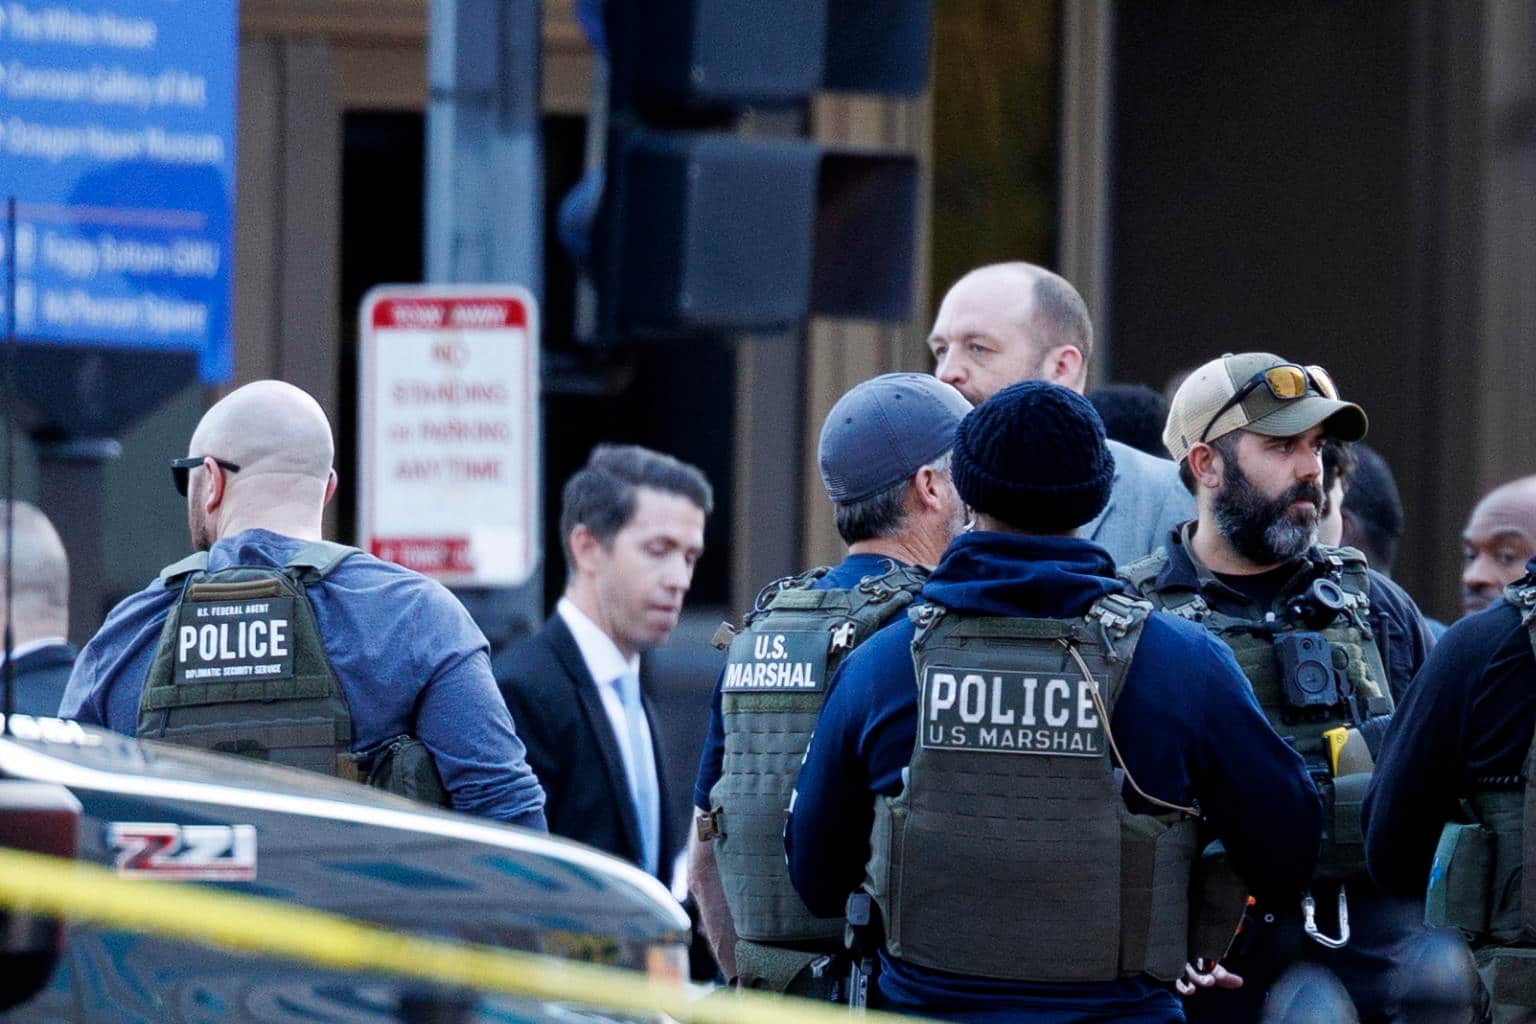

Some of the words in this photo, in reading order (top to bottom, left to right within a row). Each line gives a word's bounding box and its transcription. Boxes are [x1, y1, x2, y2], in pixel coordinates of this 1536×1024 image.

[432, 343, 468, 366] NO
[393, 383, 508, 404] STANDING
[211, 605, 244, 617] FEDERAL
[245, 603, 269, 614] AGENT
[179, 619, 288, 663] POLICE
[754, 634, 788, 660] U.S.
[222, 665, 253, 677] SECURITY
[254, 663, 282, 675] SERVICE
[726, 662, 816, 688] MARSHAL
[930, 673, 1100, 729] POLICE
[929, 725, 972, 745] U.S.
[979, 728, 1097, 751] MARSHAL
